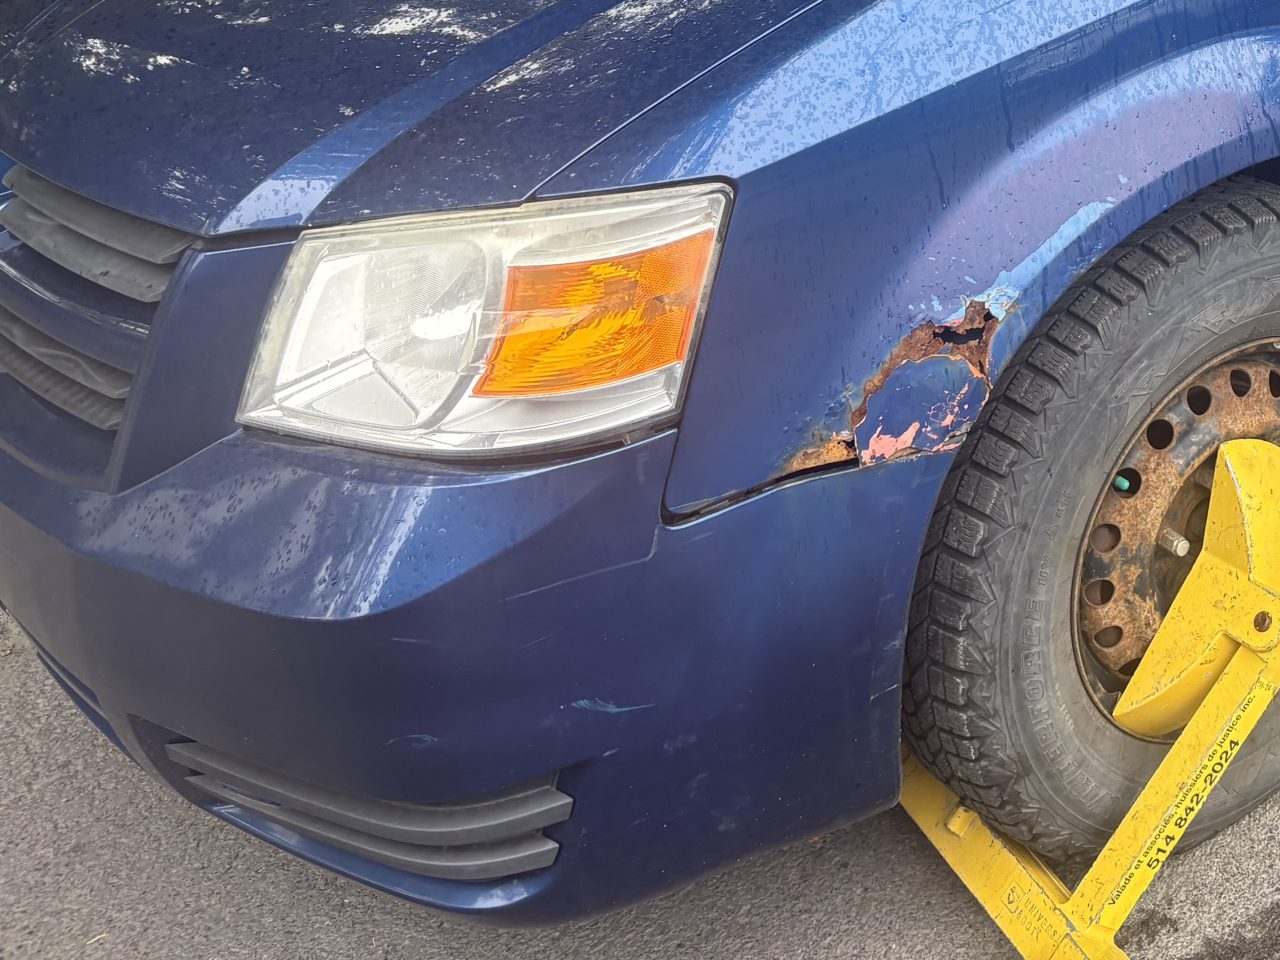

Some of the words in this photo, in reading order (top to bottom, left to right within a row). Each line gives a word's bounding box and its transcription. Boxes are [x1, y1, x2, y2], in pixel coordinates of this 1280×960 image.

[1107, 871, 1135, 906] Valade
[1134, 859, 1144, 871] et
[1174, 764, 1209, 810] huissiers
[1207, 749, 1219, 762] de
[1216, 715, 1243, 748] justice
[1241, 694, 1256, 713] inc.
[1147, 833, 1176, 870] 514
[1174, 738, 1240, 830] 842-2024
